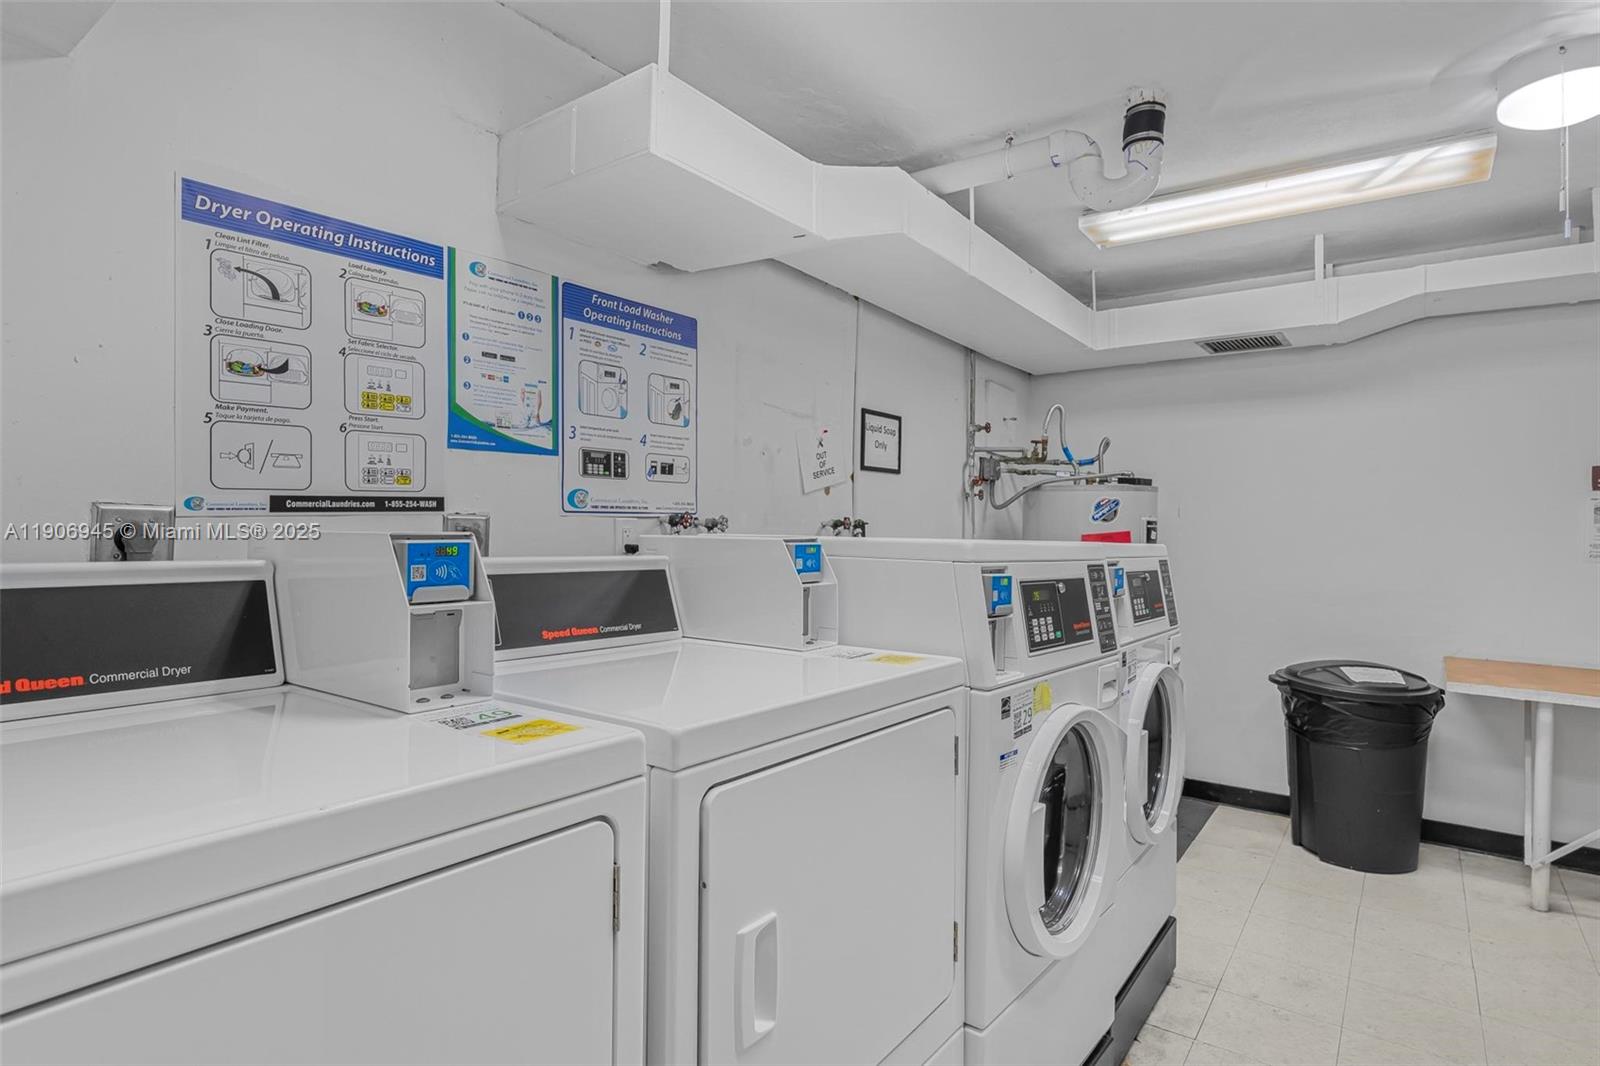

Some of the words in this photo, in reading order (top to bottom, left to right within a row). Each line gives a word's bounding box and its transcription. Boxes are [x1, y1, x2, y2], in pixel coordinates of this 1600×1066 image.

[194, 193, 252, 222] Dryer
[255, 209, 345, 248] Operating
[348, 233, 436, 267] Instructions
[206, 238, 212, 250] 1
[214, 232, 236, 242] Clean
[237, 236, 250, 244] Lint
[251, 240, 270, 249] Filter.
[348, 262, 364, 270] Load
[338, 268, 347, 278] 2
[592, 294, 618, 309] Front
[619, 301, 642, 316] Load
[642, 308, 674, 324] Washer
[203, 324, 212, 336] 3
[214, 317, 234, 326] Close
[236, 320, 264, 332] Loading
[265, 325, 284, 334] Door.
[214, 326, 235, 334] Cierre
[583, 308, 631, 330] Operating
[632, 320, 682, 341] Instructions
[568, 326, 574, 340] 1
[358, 340, 376, 348] Fabric
[640, 343, 646, 356] 2
[338, 346, 346, 356] 4
[215, 404, 236, 412] Make
[236, 406, 268, 414] Payment.
[203, 412, 213, 424] 5
[215, 412, 236, 420] Toque
[244, 414, 265, 422] tarjeta
[339, 422, 347, 432] 6
[568, 426, 576, 440] 3
[866, 422, 882, 435] Liquid
[883, 426, 896, 438] Soap
[640, 434, 647, 447] 4
[874, 440, 888, 452] Only
[816, 451, 828, 460] OUT
[819, 460, 826, 468] OF
[812, 467, 836, 480] SERVICE
[285, 499, 376, 509] CommercialLaundries.com
[384, 499, 437, 509] 1-855-254-WASH
[542, 628, 570, 640] Speed
[571, 626, 598, 636] Queen
[599, 624, 628, 634] Commercial
[628, 622, 642, 632] Dryer
[15, 675, 84, 692] Queen
[89, 667, 159, 685] Commercial
[162, 664, 192, 679] Dryer
[477, 709, 514, 721] 49
[1022, 706, 1032, 726] 29
